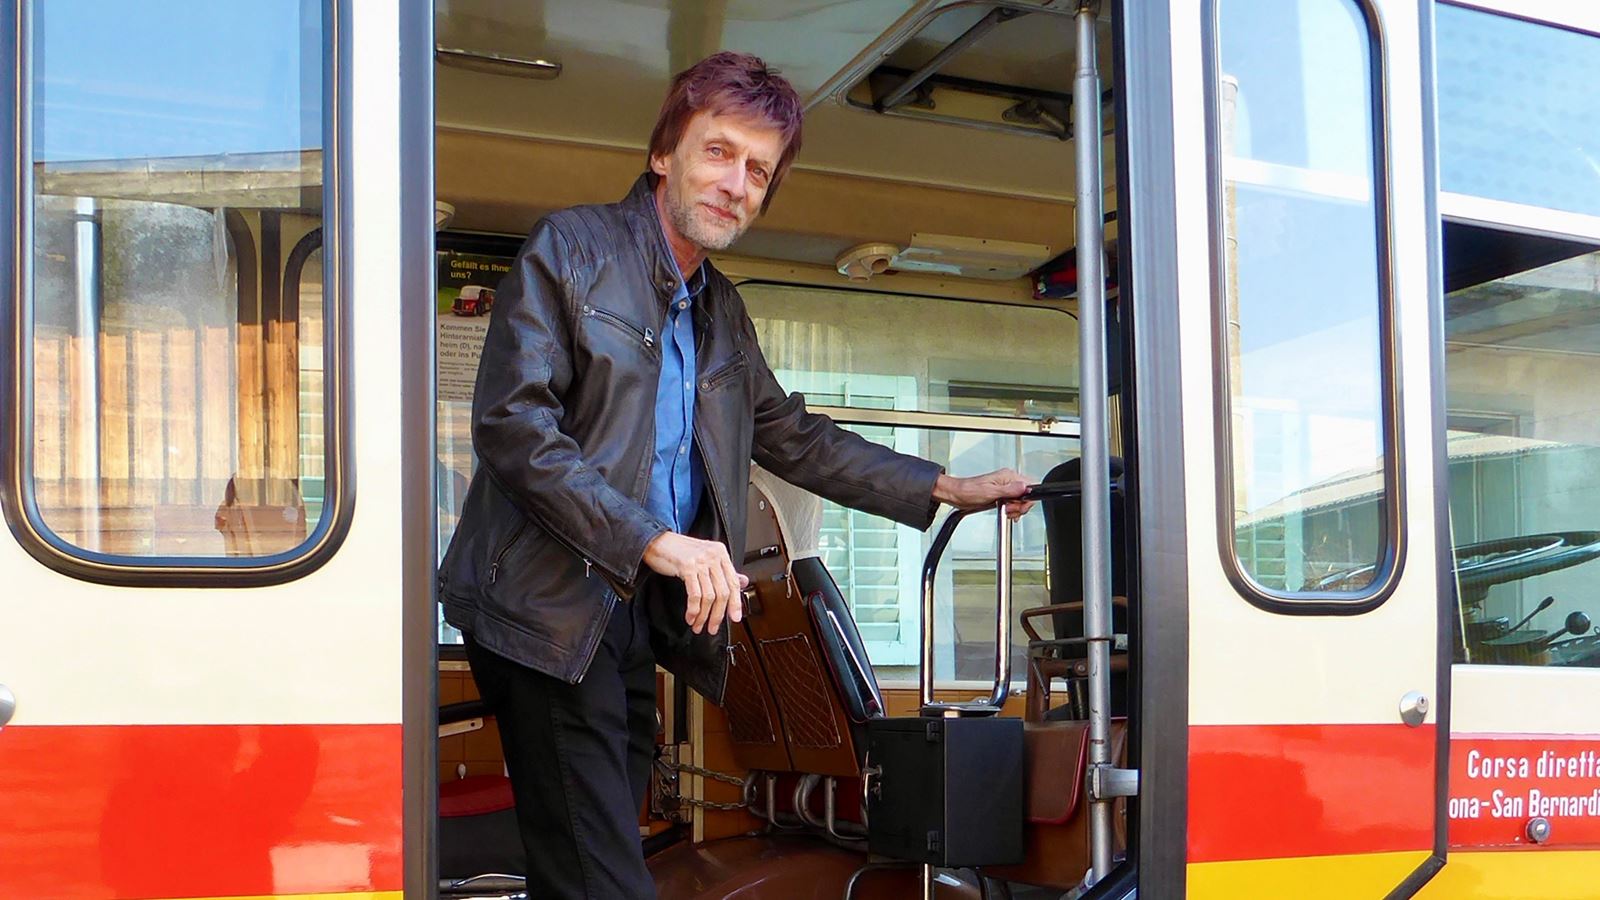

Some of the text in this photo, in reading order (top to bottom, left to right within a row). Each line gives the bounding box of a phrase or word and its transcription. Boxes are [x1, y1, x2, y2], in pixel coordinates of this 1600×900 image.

[450, 260, 478, 270] Gefällt
[450, 271, 472, 279] uns?
[440, 323, 473, 331] Kommen
[440, 341, 458, 349] heim
[440, 350, 456, 358] oder
[1467, 749, 1529, 779] Corsa
[1448, 787, 1600, 819] ona-San Bernardi
